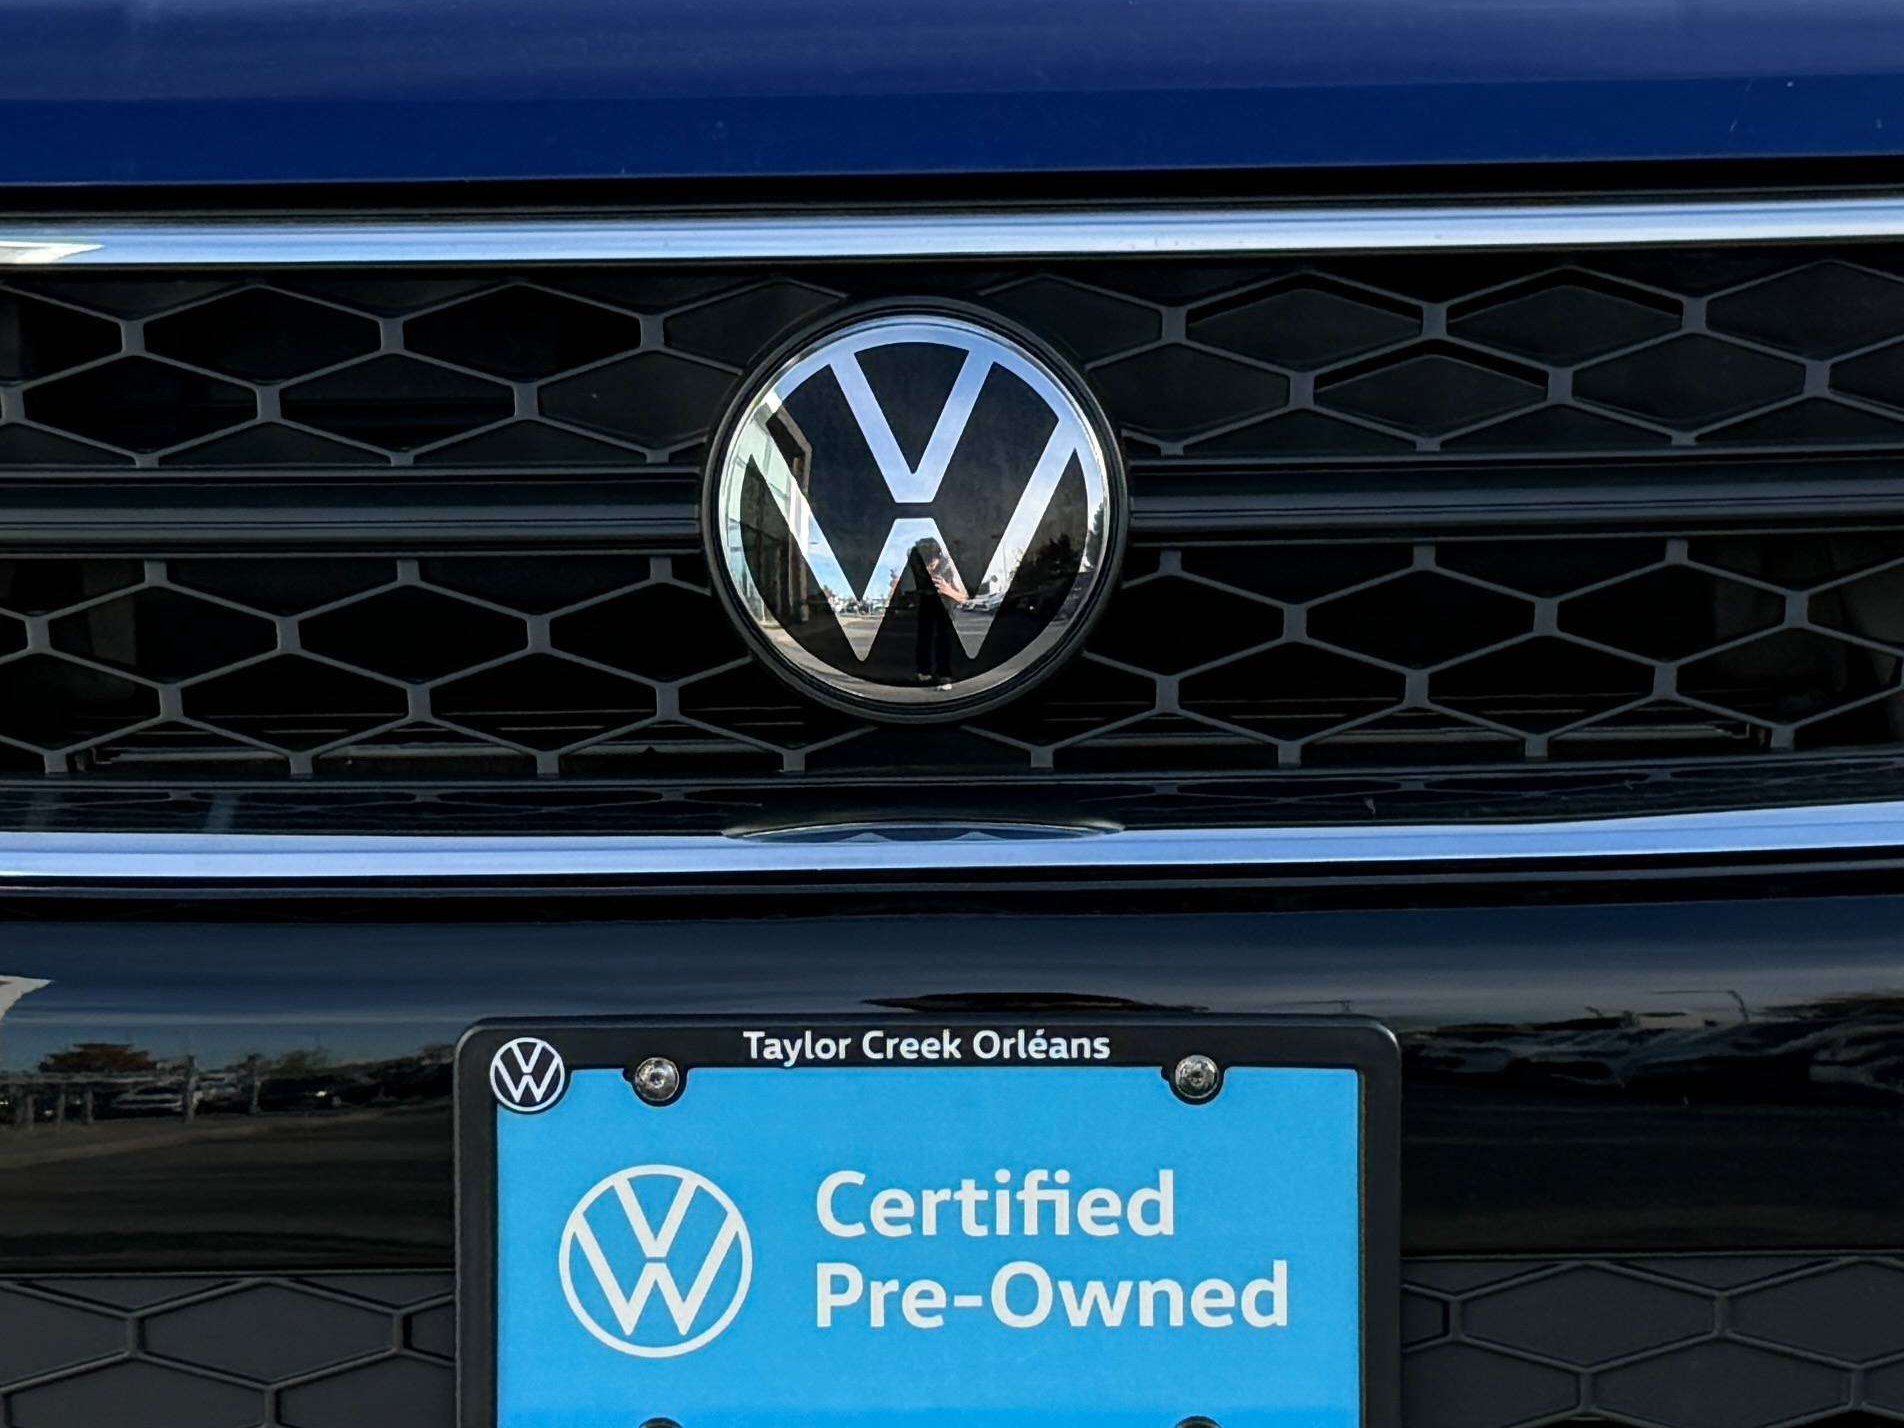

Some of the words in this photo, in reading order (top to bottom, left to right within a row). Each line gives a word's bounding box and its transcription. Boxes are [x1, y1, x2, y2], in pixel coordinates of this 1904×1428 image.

[719, 315, 1108, 703] VW
[490, 1038, 565, 1111] VW
[742, 1030, 851, 1067] Taylor
[862, 1029, 962, 1060] Creek
[972, 1028, 1111, 1060] Orléans
[815, 1169, 1175, 1238] Certified
[559, 1164, 753, 1359] VW
[815, 1259, 1288, 1329] Pre-Owned
